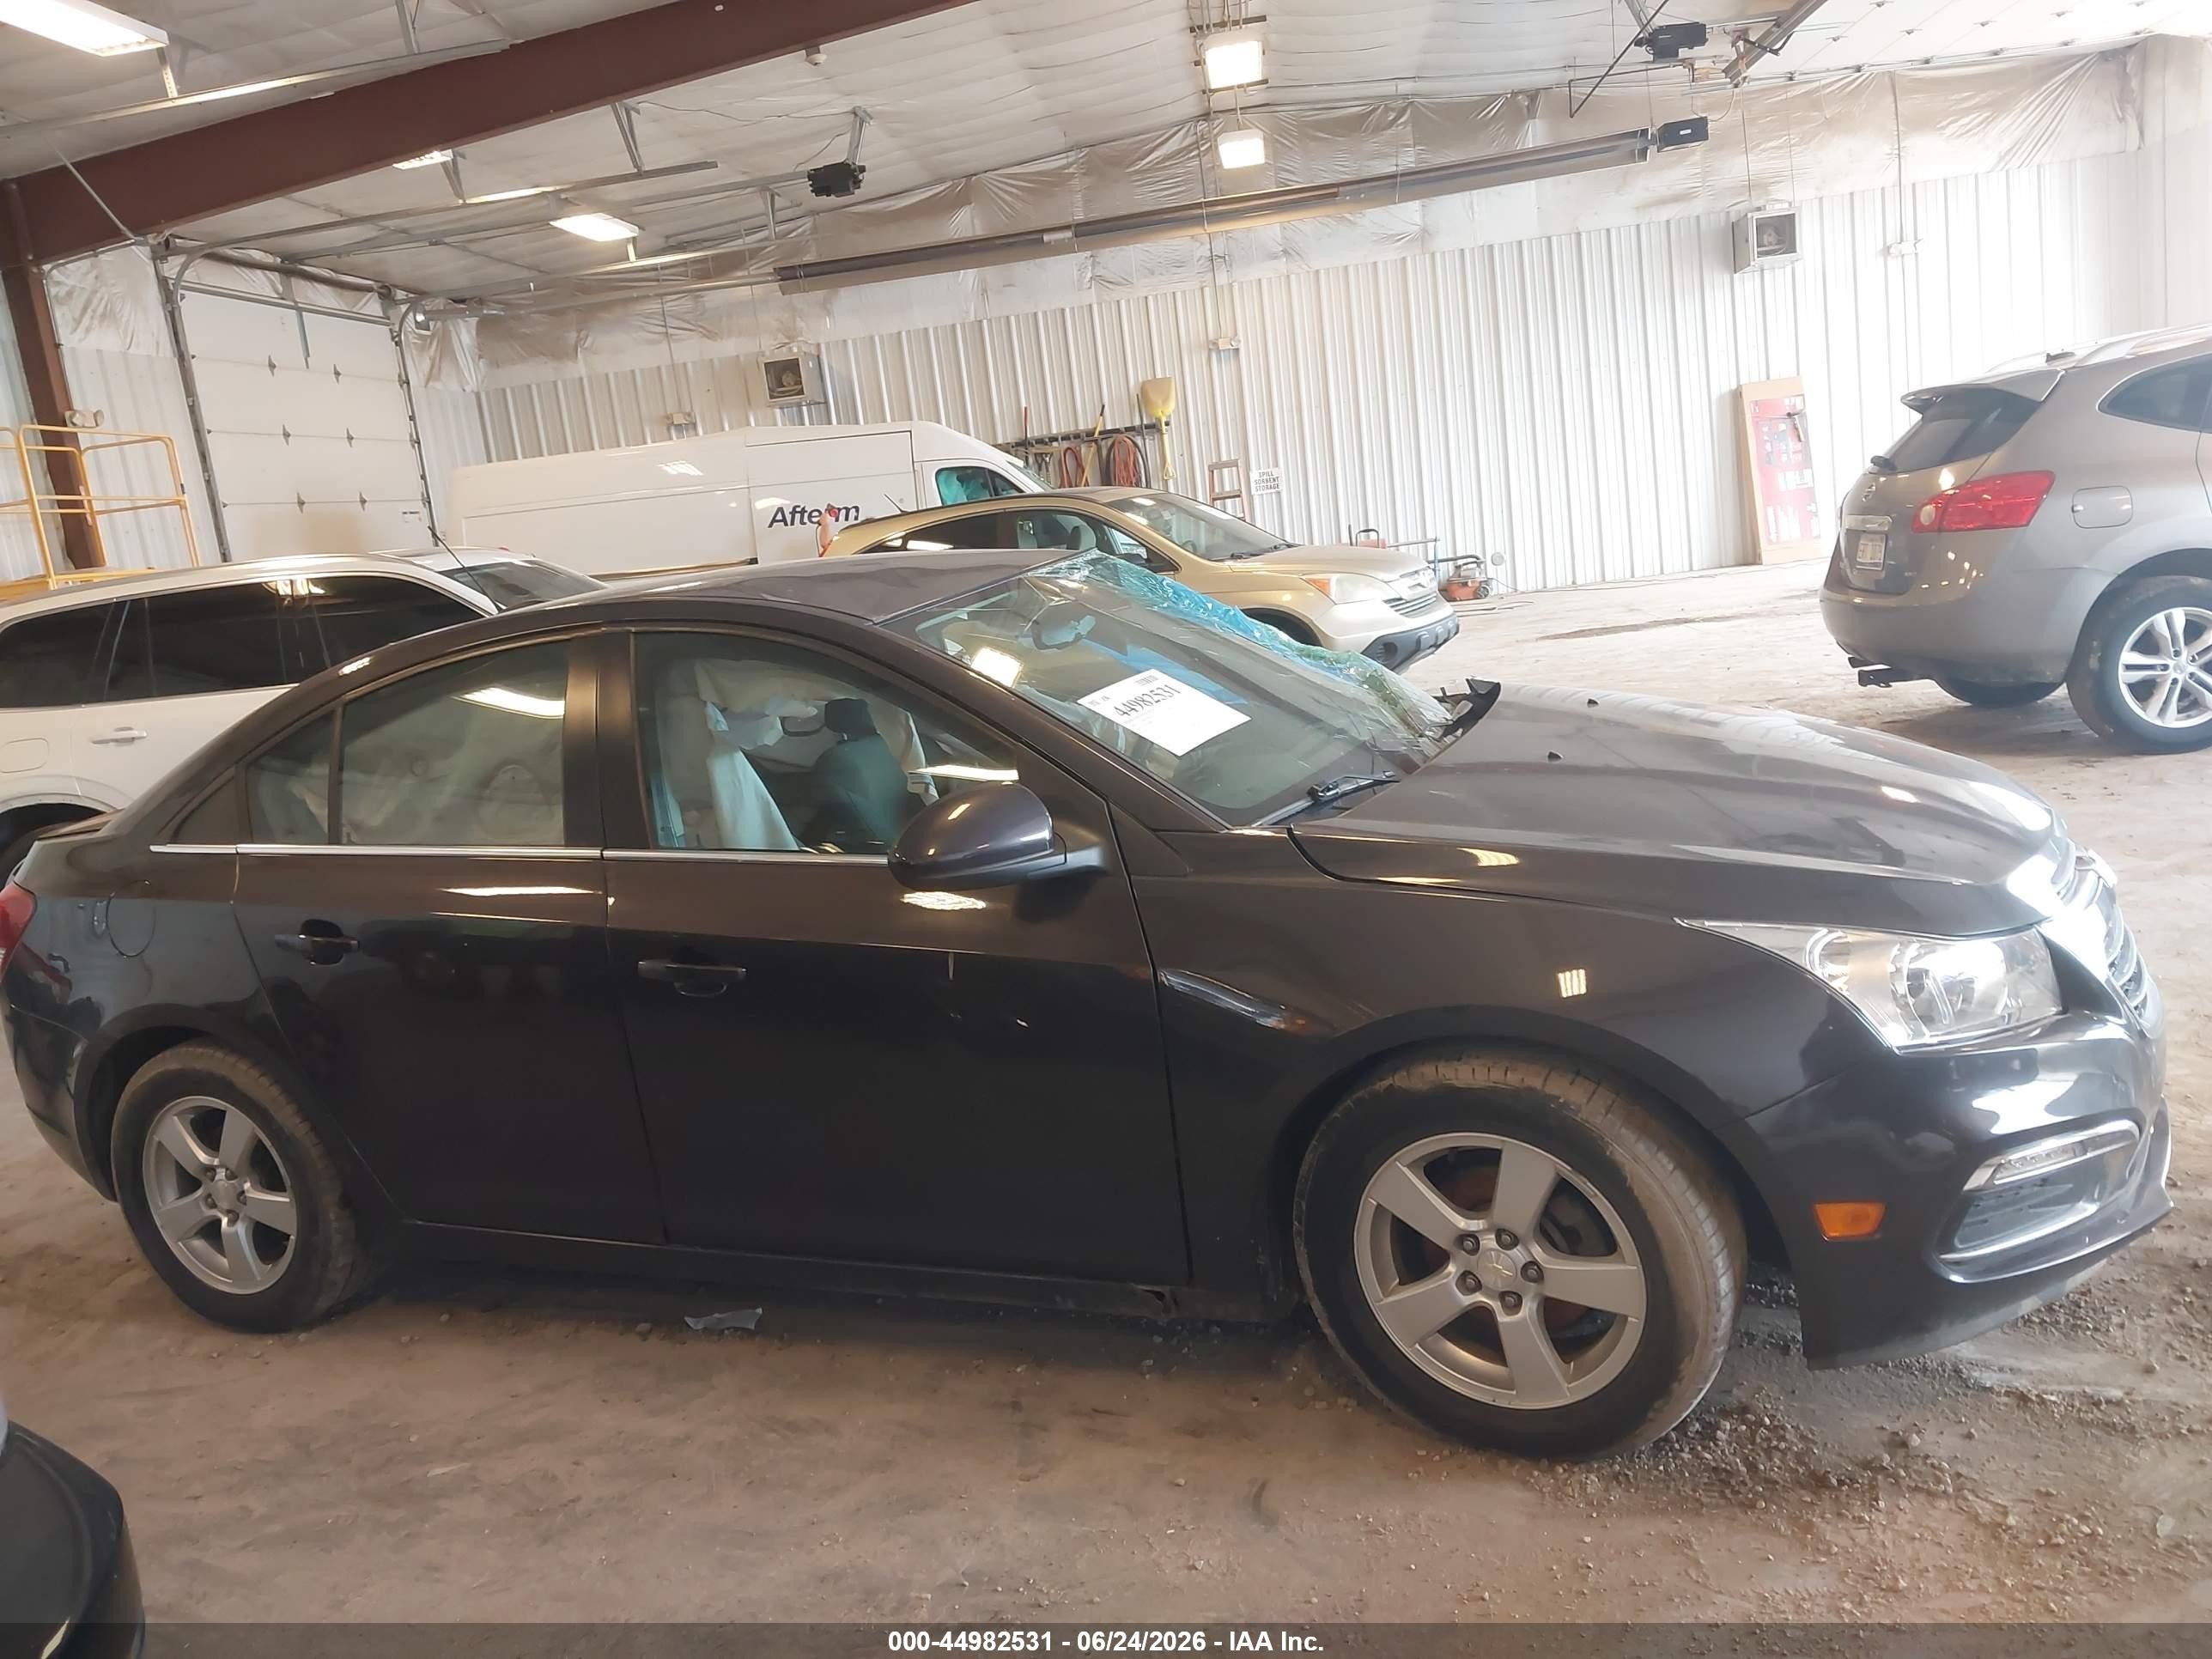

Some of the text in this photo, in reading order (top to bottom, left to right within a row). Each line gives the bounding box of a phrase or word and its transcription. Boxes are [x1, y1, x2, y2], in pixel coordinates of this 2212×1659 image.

[1255, 483, 1280, 492] STORAGE
[768, 503, 860, 528] Aftem
[1113, 684, 1182, 717] 44982531
